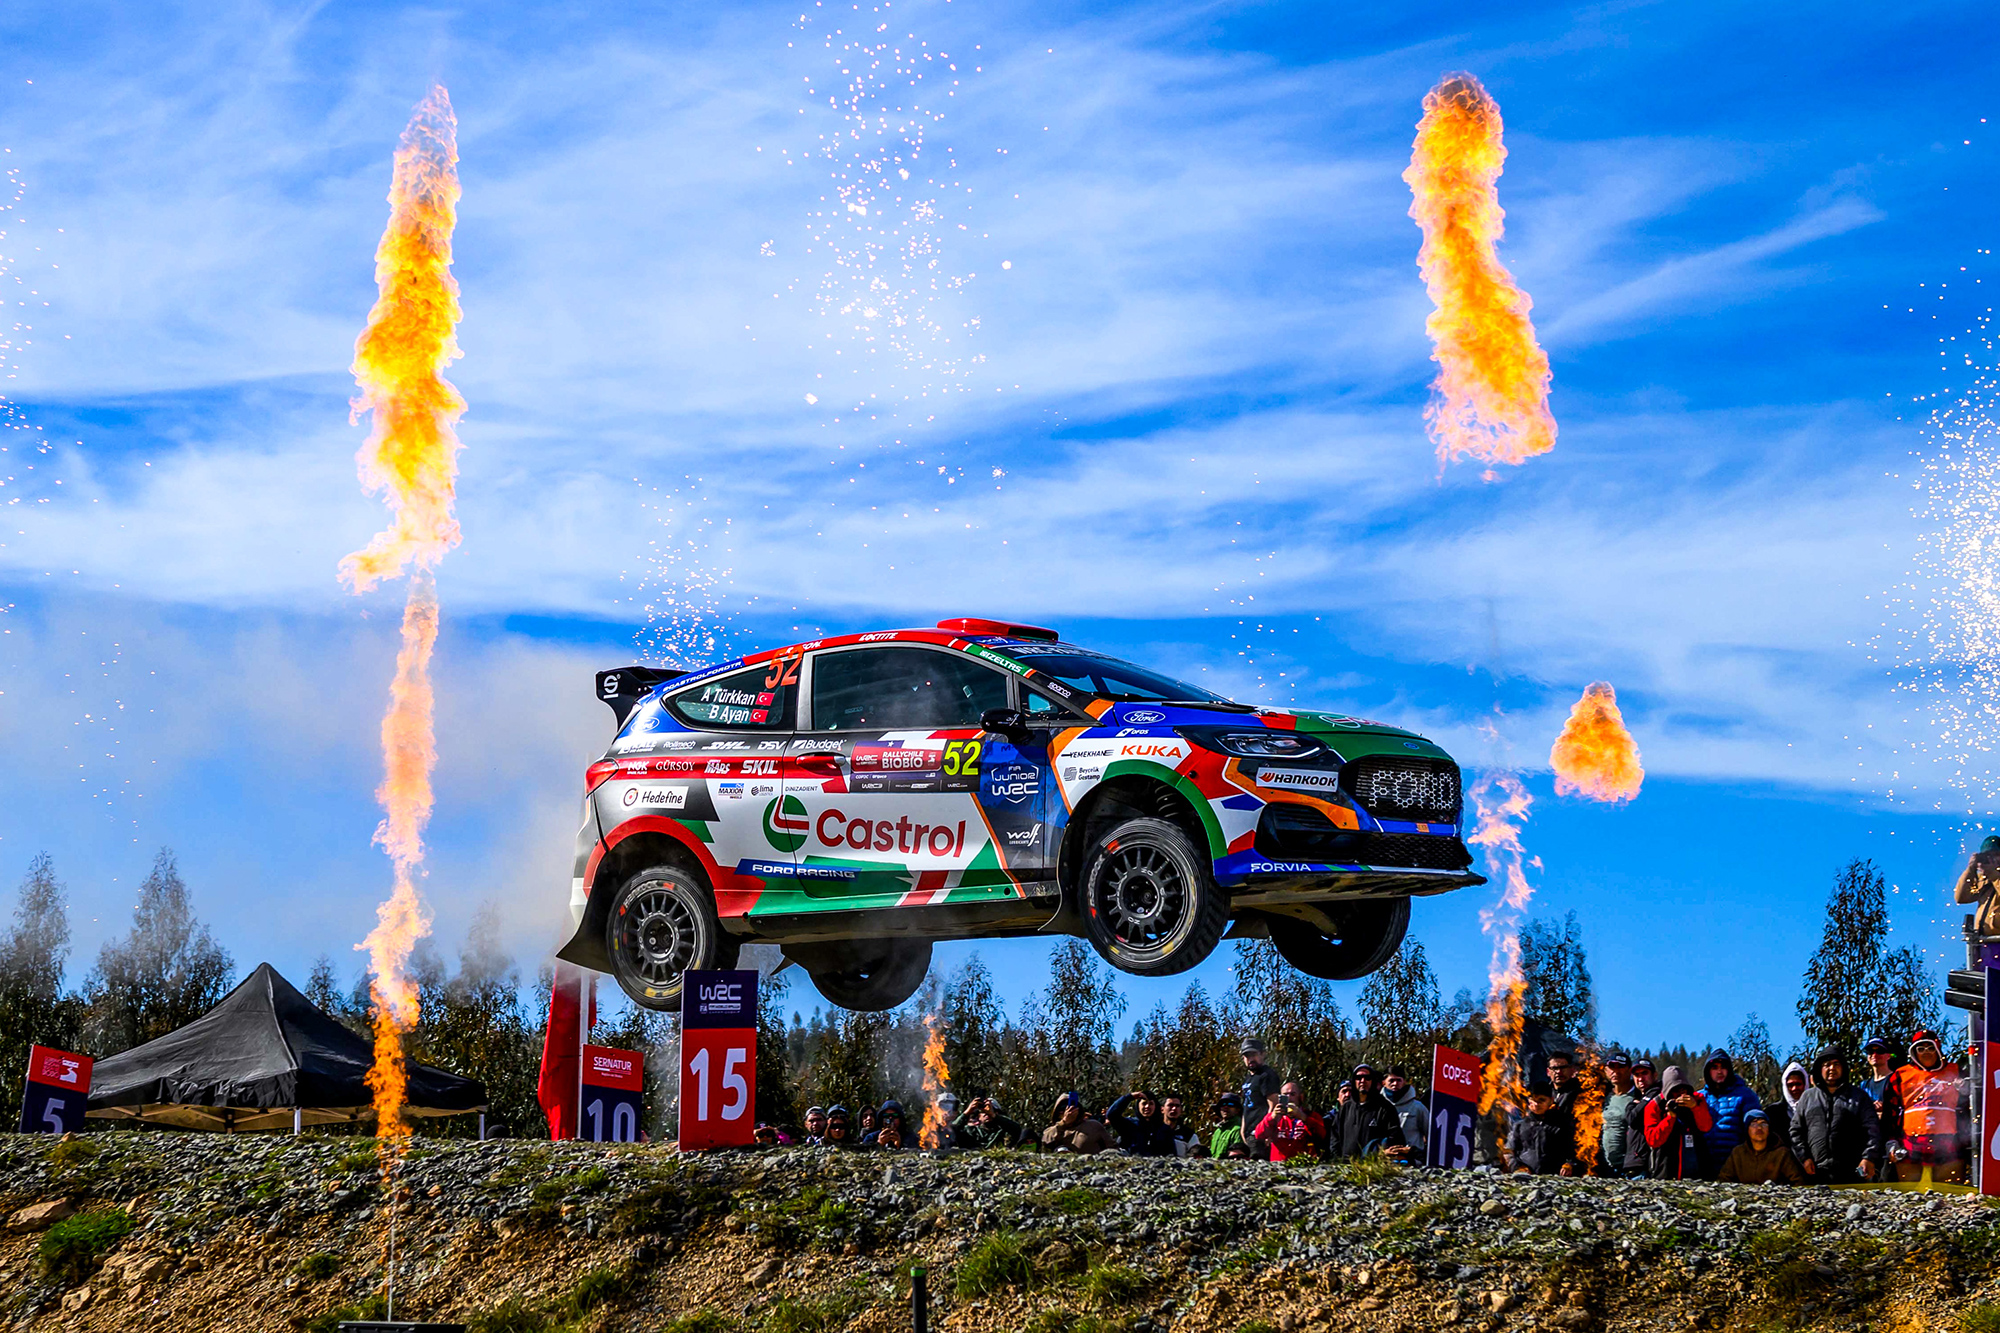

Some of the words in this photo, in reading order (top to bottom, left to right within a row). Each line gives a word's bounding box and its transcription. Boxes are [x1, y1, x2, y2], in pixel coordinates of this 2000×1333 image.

[859, 632, 899, 641] LOCTITE
[765, 645, 802, 689] 52
[700, 688, 711, 701] A
[713, 689, 755, 706] Türkkan
[709, 705, 720, 719] B
[720, 706, 750, 724] Ayan
[1128, 711, 1160, 723] Ford
[706, 741, 748, 750] DHL
[757, 741, 786, 750] DSV
[805, 739, 843, 751] Budget
[1121, 745, 1182, 759] KUKA
[628, 761, 649, 771] NGK
[655, 760, 695, 772] GÜRSOY
[943, 741, 982, 776] 52
[740, 760, 778, 775] SKIL
[994, 772, 1036, 782] JUNIOR
[759, 784, 774, 793] lima
[991, 781, 1039, 796] WRC
[1369, 770, 1454, 810] FORD
[641, 790, 683, 804] Hedefine
[816, 809, 966, 857] Castrol
[752, 864, 794, 875] FORD
[796, 867, 855, 878] RACING
[1250, 862, 1311, 873] FORVIA
[699, 984, 743, 1001] WRC
[593, 1056, 632, 1071] SERNATUR
[1442, 1063, 1472, 1085] COPEC
[689, 1047, 748, 1121] 15
[41, 1097, 66, 1134] 5
[586, 1098, 636, 1143] 10
[1435, 1108, 1472, 1170] 15
